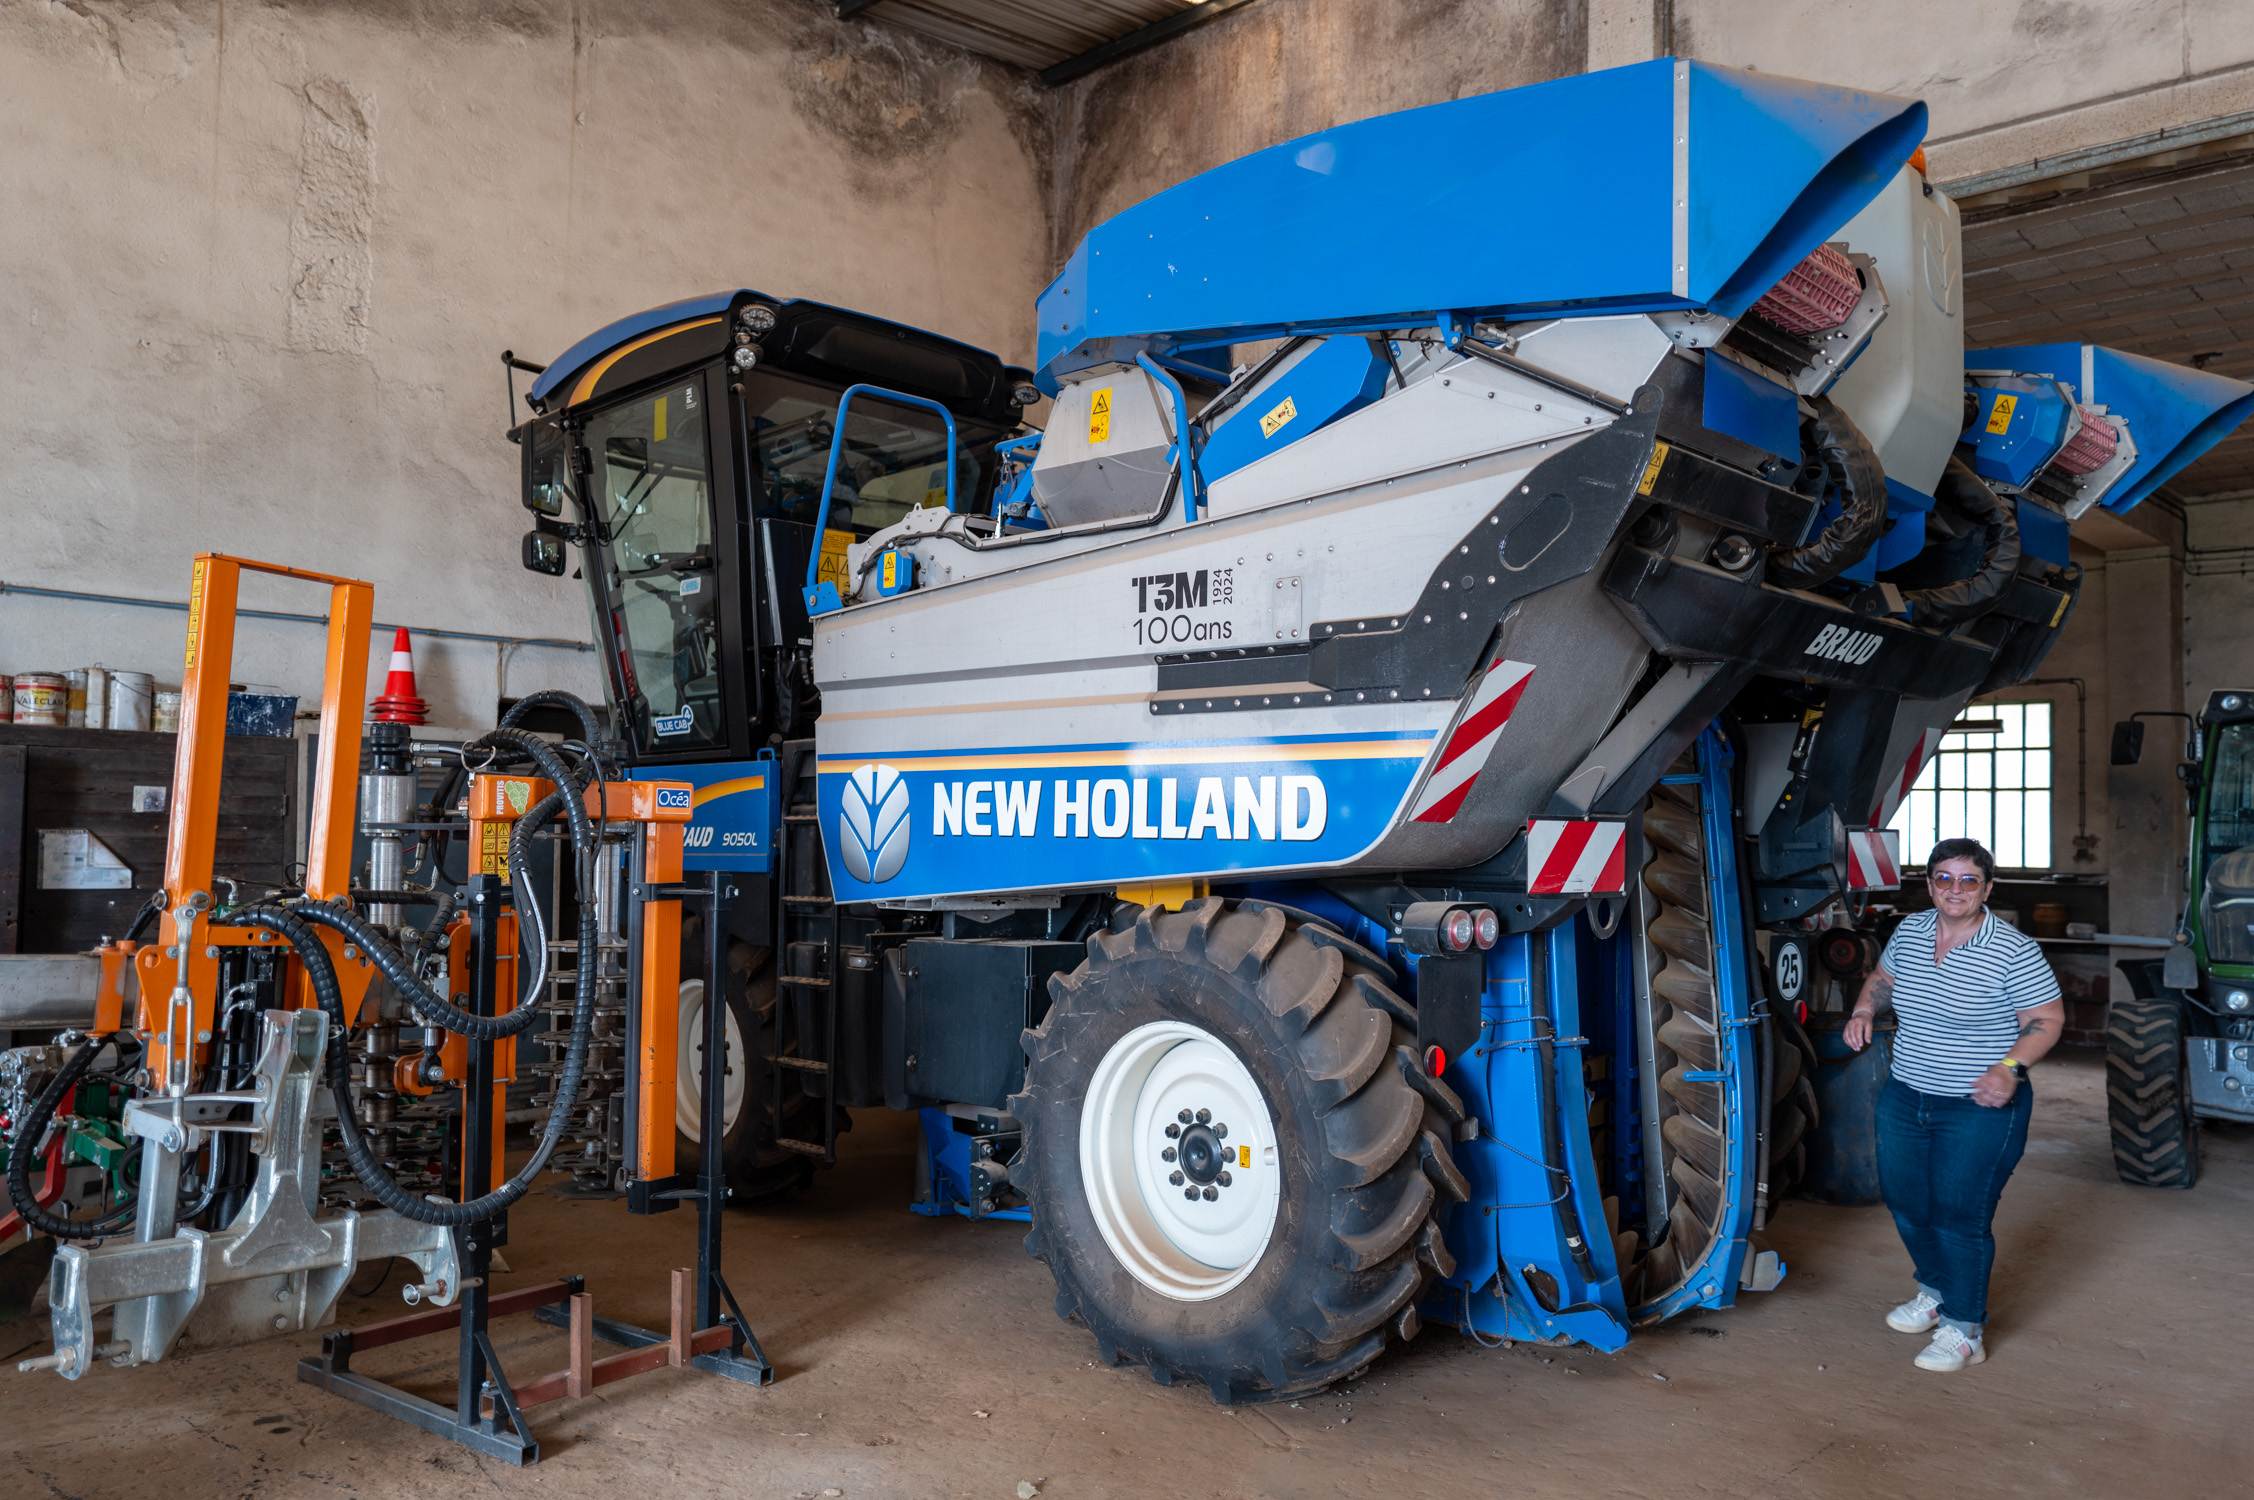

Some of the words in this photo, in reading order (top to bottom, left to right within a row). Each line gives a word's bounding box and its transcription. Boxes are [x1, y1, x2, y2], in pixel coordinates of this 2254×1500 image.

[1131, 569, 1208, 613] T3M
[1212, 569, 1222, 605] 1924
[1223, 568, 1233, 605] 2024
[1803, 623, 1884, 665] BRAUD
[657, 720, 674, 732] BLUE
[673, 719, 688, 730] CAB
[684, 708, 692, 720] 4
[496, 780, 505, 815] PROVITIS
[933, 780, 1042, 838] NEW
[1053, 775, 1328, 841] HOLLAND
[683, 826, 714, 847] AUD
[722, 832, 758, 847] 9050L
[1781, 953, 1799, 990] 25
